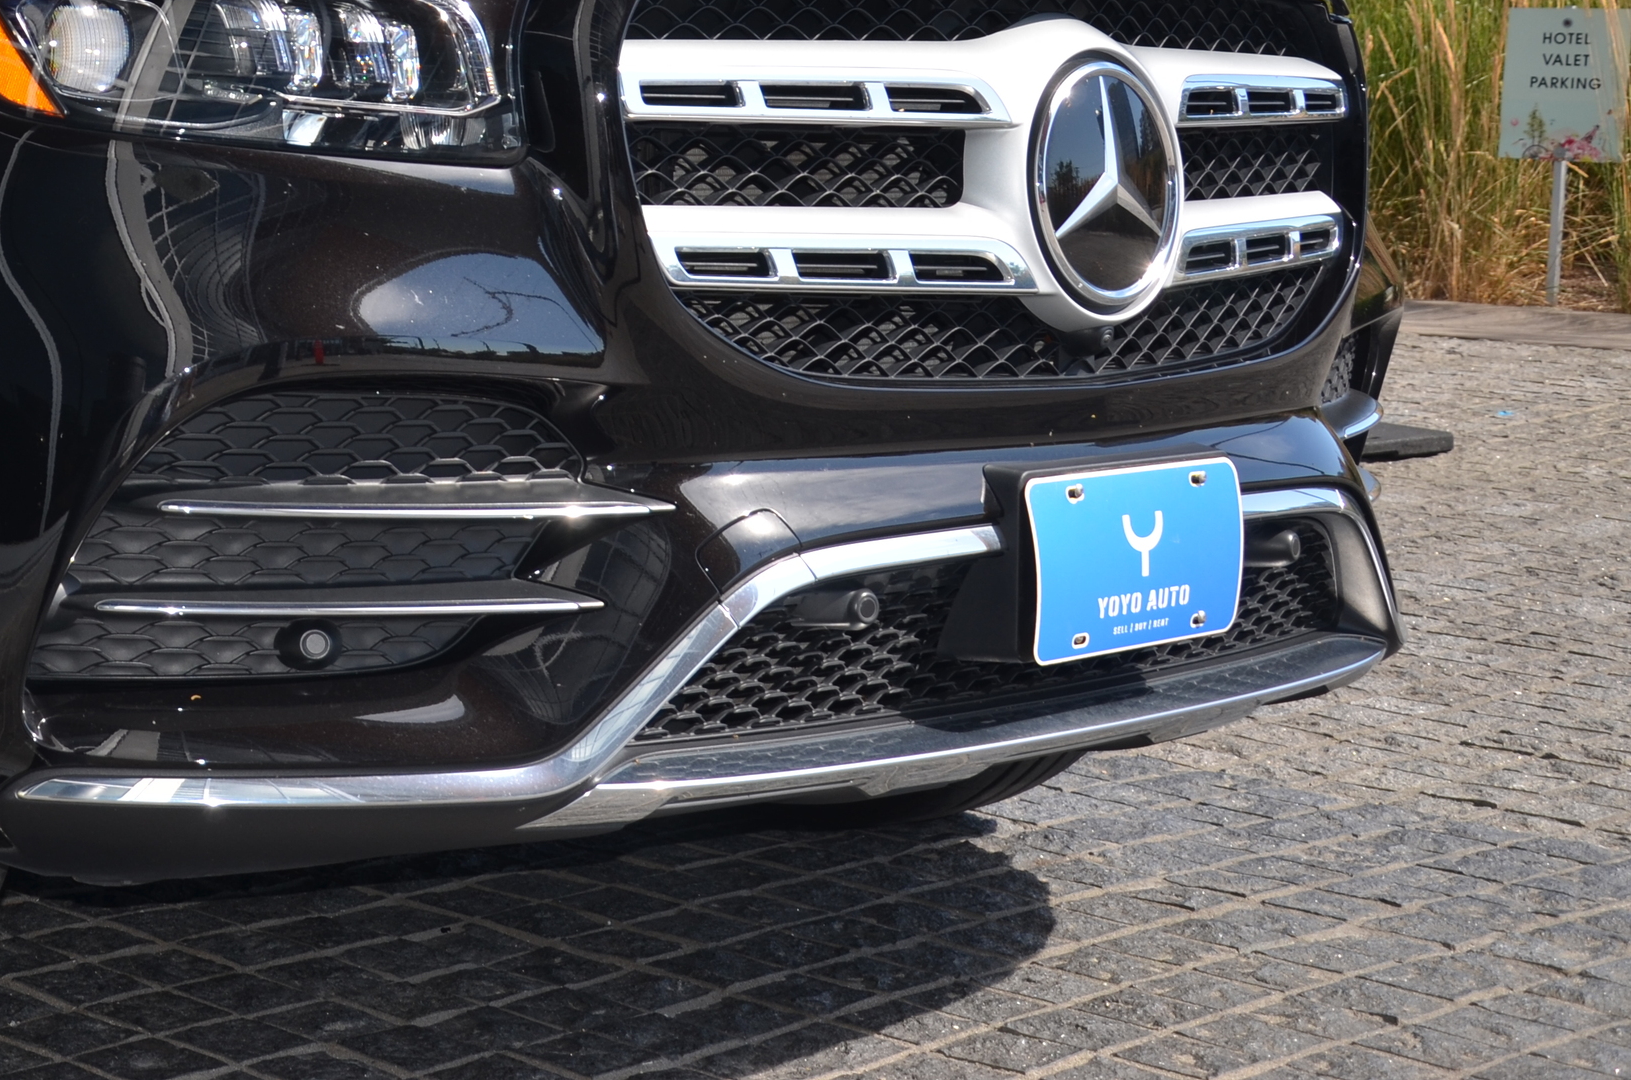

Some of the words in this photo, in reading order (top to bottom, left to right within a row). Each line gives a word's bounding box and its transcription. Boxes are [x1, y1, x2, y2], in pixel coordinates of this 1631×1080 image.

[1542, 32, 1591, 45] HOTEL
[1542, 53, 1590, 67] VALET
[1530, 76, 1602, 90] PARKING
[1097, 591, 1143, 620] YOYO
[1145, 584, 1191, 612] AUTO
[1113, 624, 1128, 635] SELL
